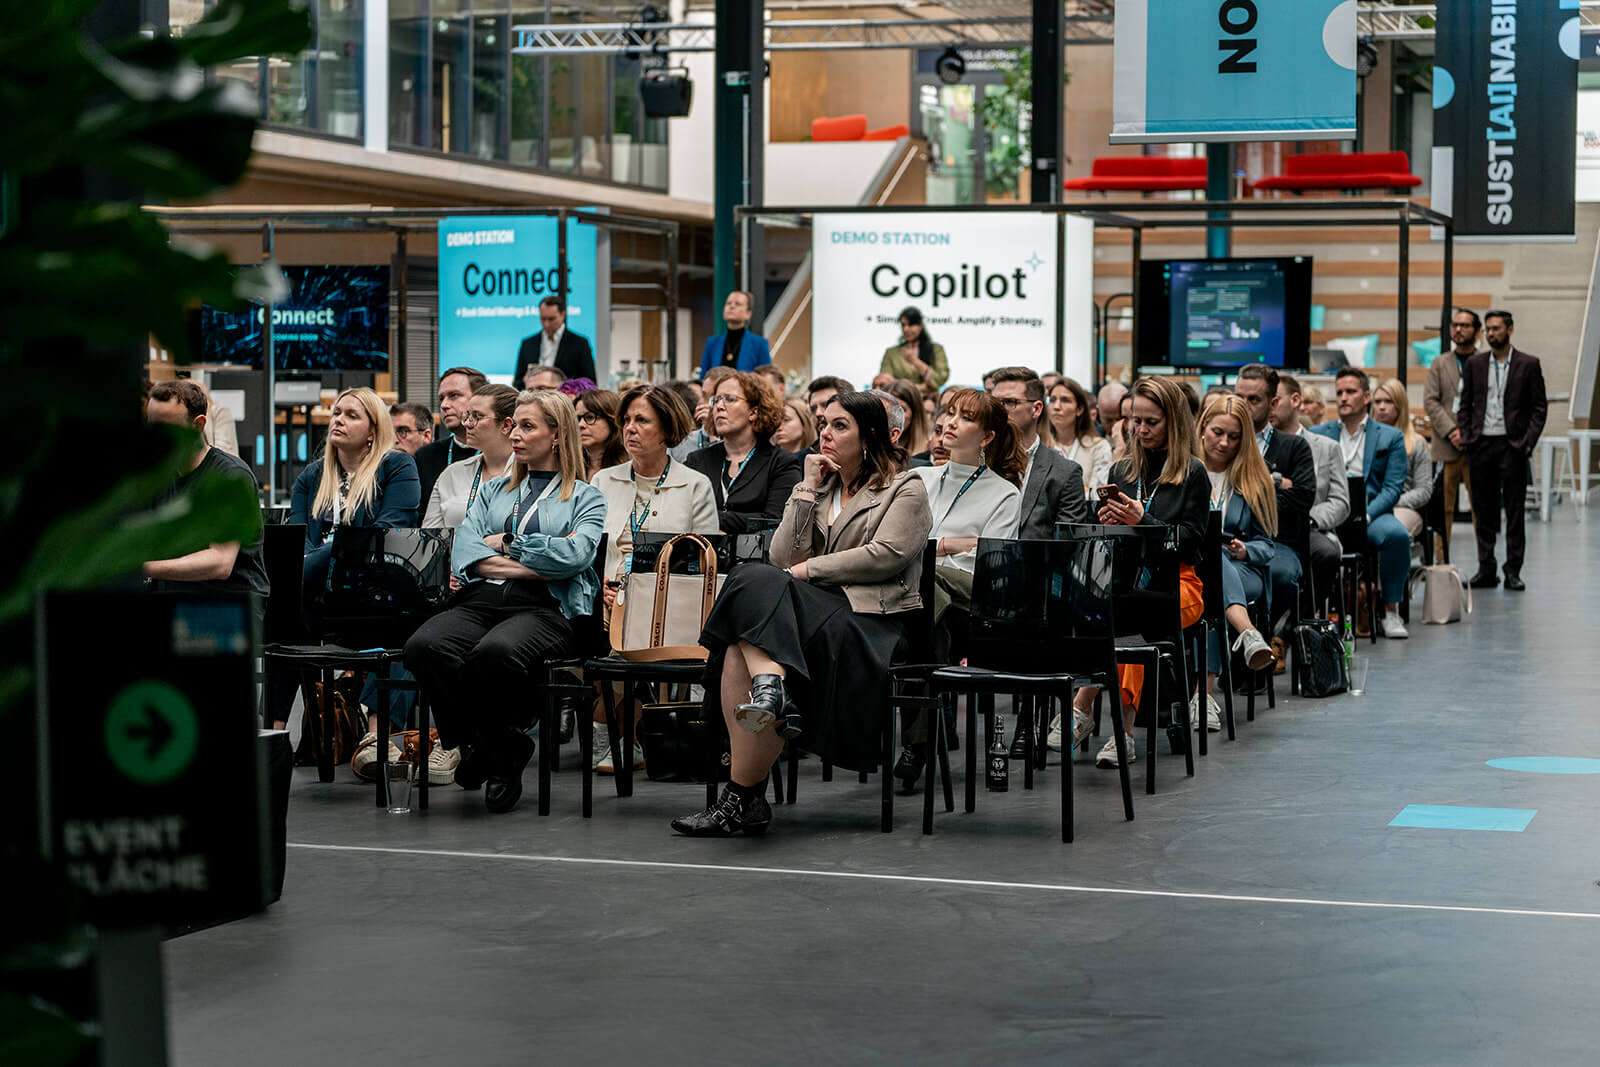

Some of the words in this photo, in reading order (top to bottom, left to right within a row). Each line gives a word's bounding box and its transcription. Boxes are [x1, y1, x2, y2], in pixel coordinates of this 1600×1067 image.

[446, 231, 474, 247] DEMO
[474, 229, 515, 245] STATION
[831, 231, 878, 244] DEMO
[882, 232, 951, 245] STATION
[870, 263, 1027, 307] Copilot
[957, 316, 996, 327] Amplify
[1000, 316, 1046, 328] Strategy.
[659, 561, 667, 592] COACH
[63, 816, 184, 856] EVENT
